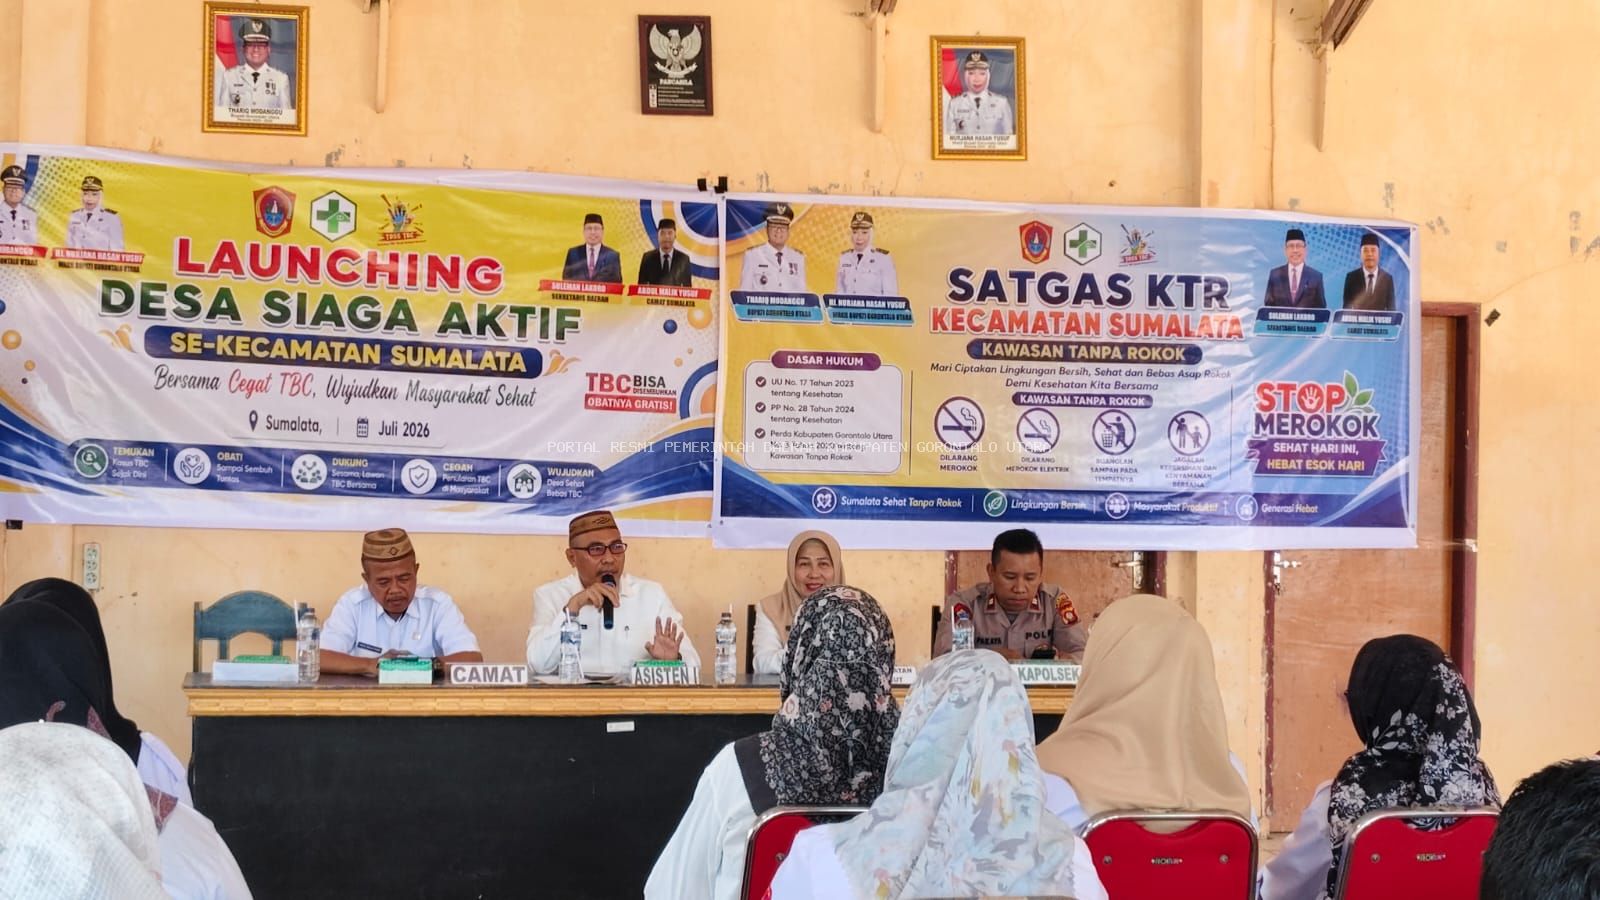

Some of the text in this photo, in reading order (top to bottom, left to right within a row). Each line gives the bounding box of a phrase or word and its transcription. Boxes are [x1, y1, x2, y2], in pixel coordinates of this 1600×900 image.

[176, 237, 503, 294] LAUNCHING
[947, 267, 1230, 309] SATGAS KTR
[100, 278, 582, 342] DESA SIAGA AKTIF
[931, 307, 1244, 340] KECAMATAN SUMALATA
[169, 331, 527, 374] SE-KECAMATAN SUMALATA
[982, 342, 1186, 361] KAWASAN TANPA ROKOK
[787, 354, 864, 366] DASAR HUKUM
[930, 362, 953, 371] Mari
[954, 363, 998, 373] Ciptakan
[999, 365, 1056, 377] Lingkungan
[1058, 366, 1091, 376] Bersih,
[1094, 367, 1122, 376] Sehat
[1125, 368, 1143, 376] dan
[1146, 368, 1175, 377] Bebas
[1177, 369, 1202, 379] Asap
[153, 364, 537, 409] Bersama Cegat TBC, Wujudkan Masyarakat Sehat
[585, 372, 632, 394] TBC
[633, 374, 667, 389] BISA
[770, 378, 783, 386] UU
[809, 379, 833, 387] Tahun
[834, 380, 855, 388] 2023
[1005, 378, 1159, 390] Demi Kesehatan Kita Bersama
[770, 389, 844, 398] tentang Kesehatan
[1019, 393, 1146, 406] KAWASAN TANPA ROKOK
[1256, 382, 1346, 414] STOP
[587, 397, 674, 411] OBATNYA GRATIS!
[834, 405, 855, 413] 2024
[265, 414, 323, 436] Sumalata,
[770, 415, 843, 424] tentang Kesehatan
[1253, 412, 1379, 438] MEROKOK
[378, 420, 431, 439] Juli 2026
[770, 429, 792, 437] Perda
[793, 430, 834, 439] Kabupaten
[834, 431, 871, 439] Gorontalo
[112, 446, 155, 458] TEMUKAN
[1273, 442, 1359, 456] SEHAT HARI INI,
[216, 451, 244, 461] OBATI
[331, 457, 369, 467] DUKUNG
[805, 453, 829, 461] Tanpa
[134, 459, 150, 468] TBC
[216, 463, 273, 475] Sampai Sembuh
[442, 462, 474, 472] CEGAH
[1266, 458, 1365, 472] HEBAT ESOK HARI
[111, 468, 131, 478] Sejak
[442, 473, 491, 483] Penularan TBC
[546, 467, 595, 477] WUJUDKAN
[331, 479, 377, 489] TBC Bersama
[546, 478, 585, 488] Desa Sehat
[449, 486, 490, 495] Masyarakat
[568, 489, 583, 498] TBC
[840, 495, 963, 510] Sumalata Sehat Tanpa Rokok
[1010, 499, 1059, 512] Lingkungan
[1133, 501, 1181, 514] Masyarakat
[1261, 503, 1319, 513] Generasi Hebat
[452, 666, 526, 683] CAMAT
[634, 666, 690, 685] ASISTEN
[1018, 667, 1081, 682] KAPOLSEK
